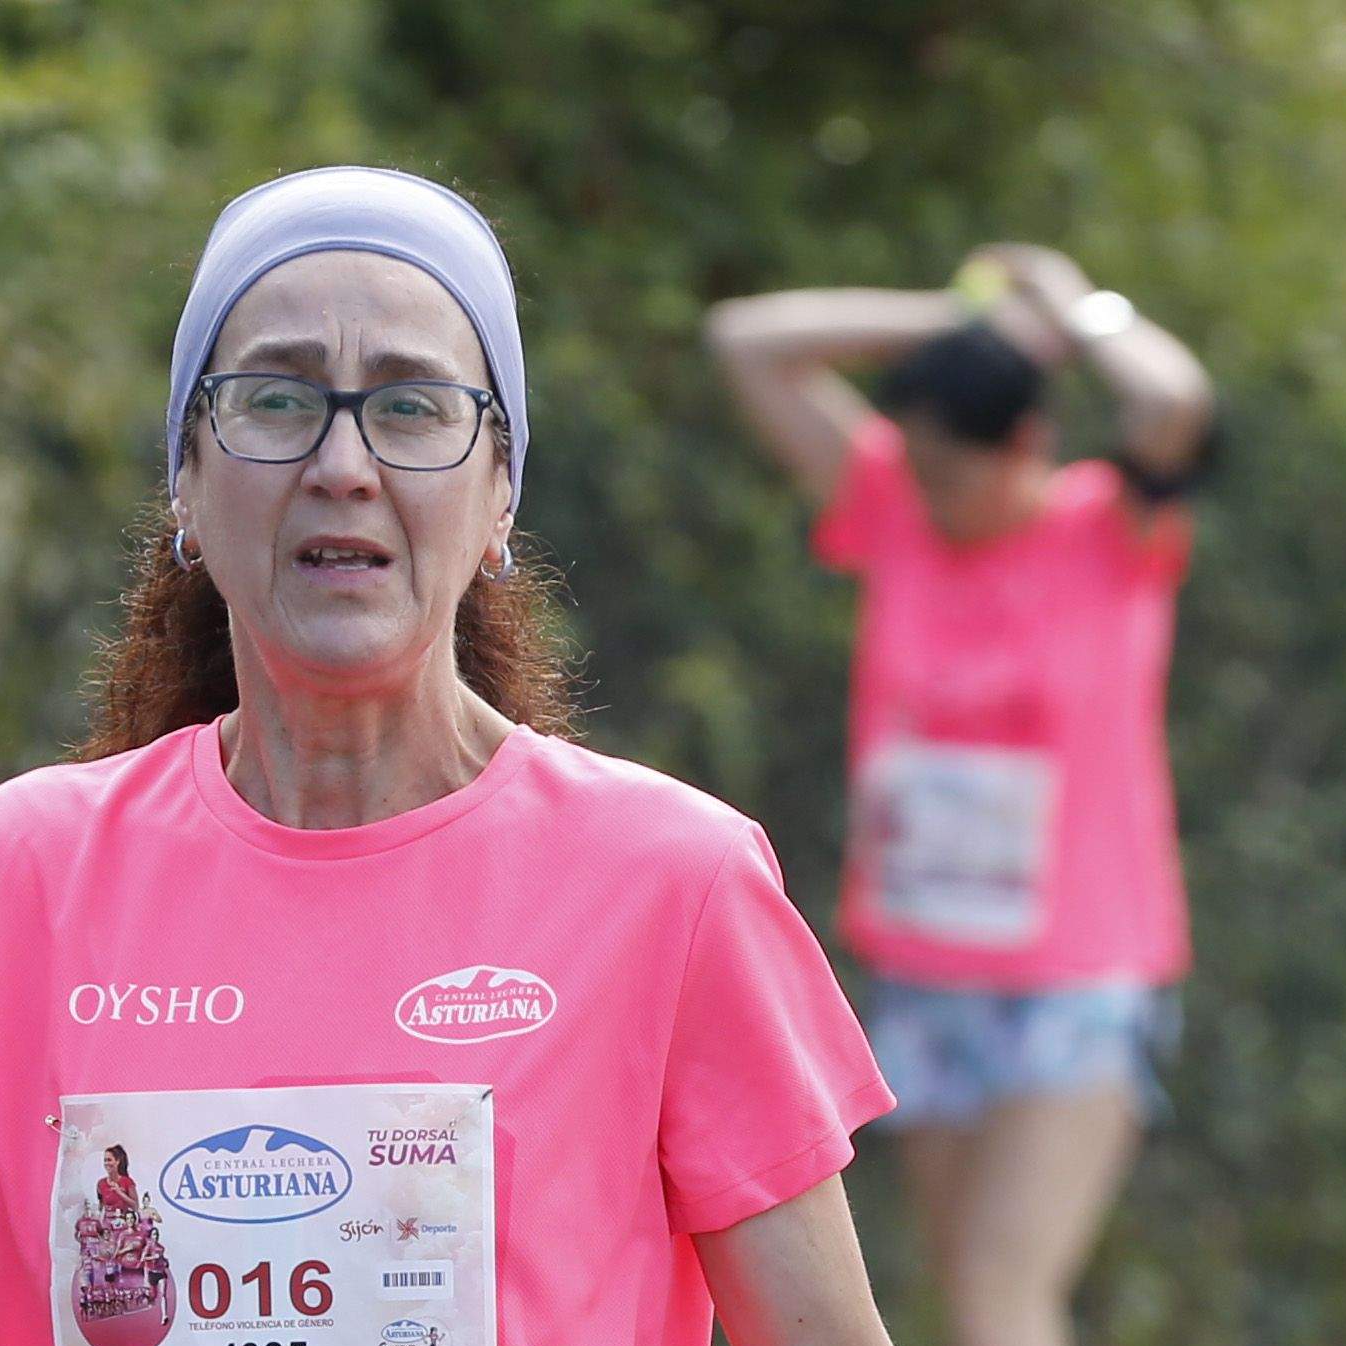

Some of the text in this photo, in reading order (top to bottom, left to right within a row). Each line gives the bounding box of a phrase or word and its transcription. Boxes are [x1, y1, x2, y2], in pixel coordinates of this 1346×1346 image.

[68, 983, 245, 1025] OYSHO
[406, 996, 542, 1026] ASTURIANA
[368, 1129, 458, 1142] TU DORSAL
[204, 1157, 331, 1170] CENTRAL LECHERA
[369, 1144, 456, 1166] SUMA
[174, 1163, 339, 1200] ASTURIANA
[339, 1220, 384, 1242] gijón
[188, 1260, 333, 1320] 016
[189, 1319, 334, 1331] TELÉFONO VIOLENCIA DE GÉNERO
